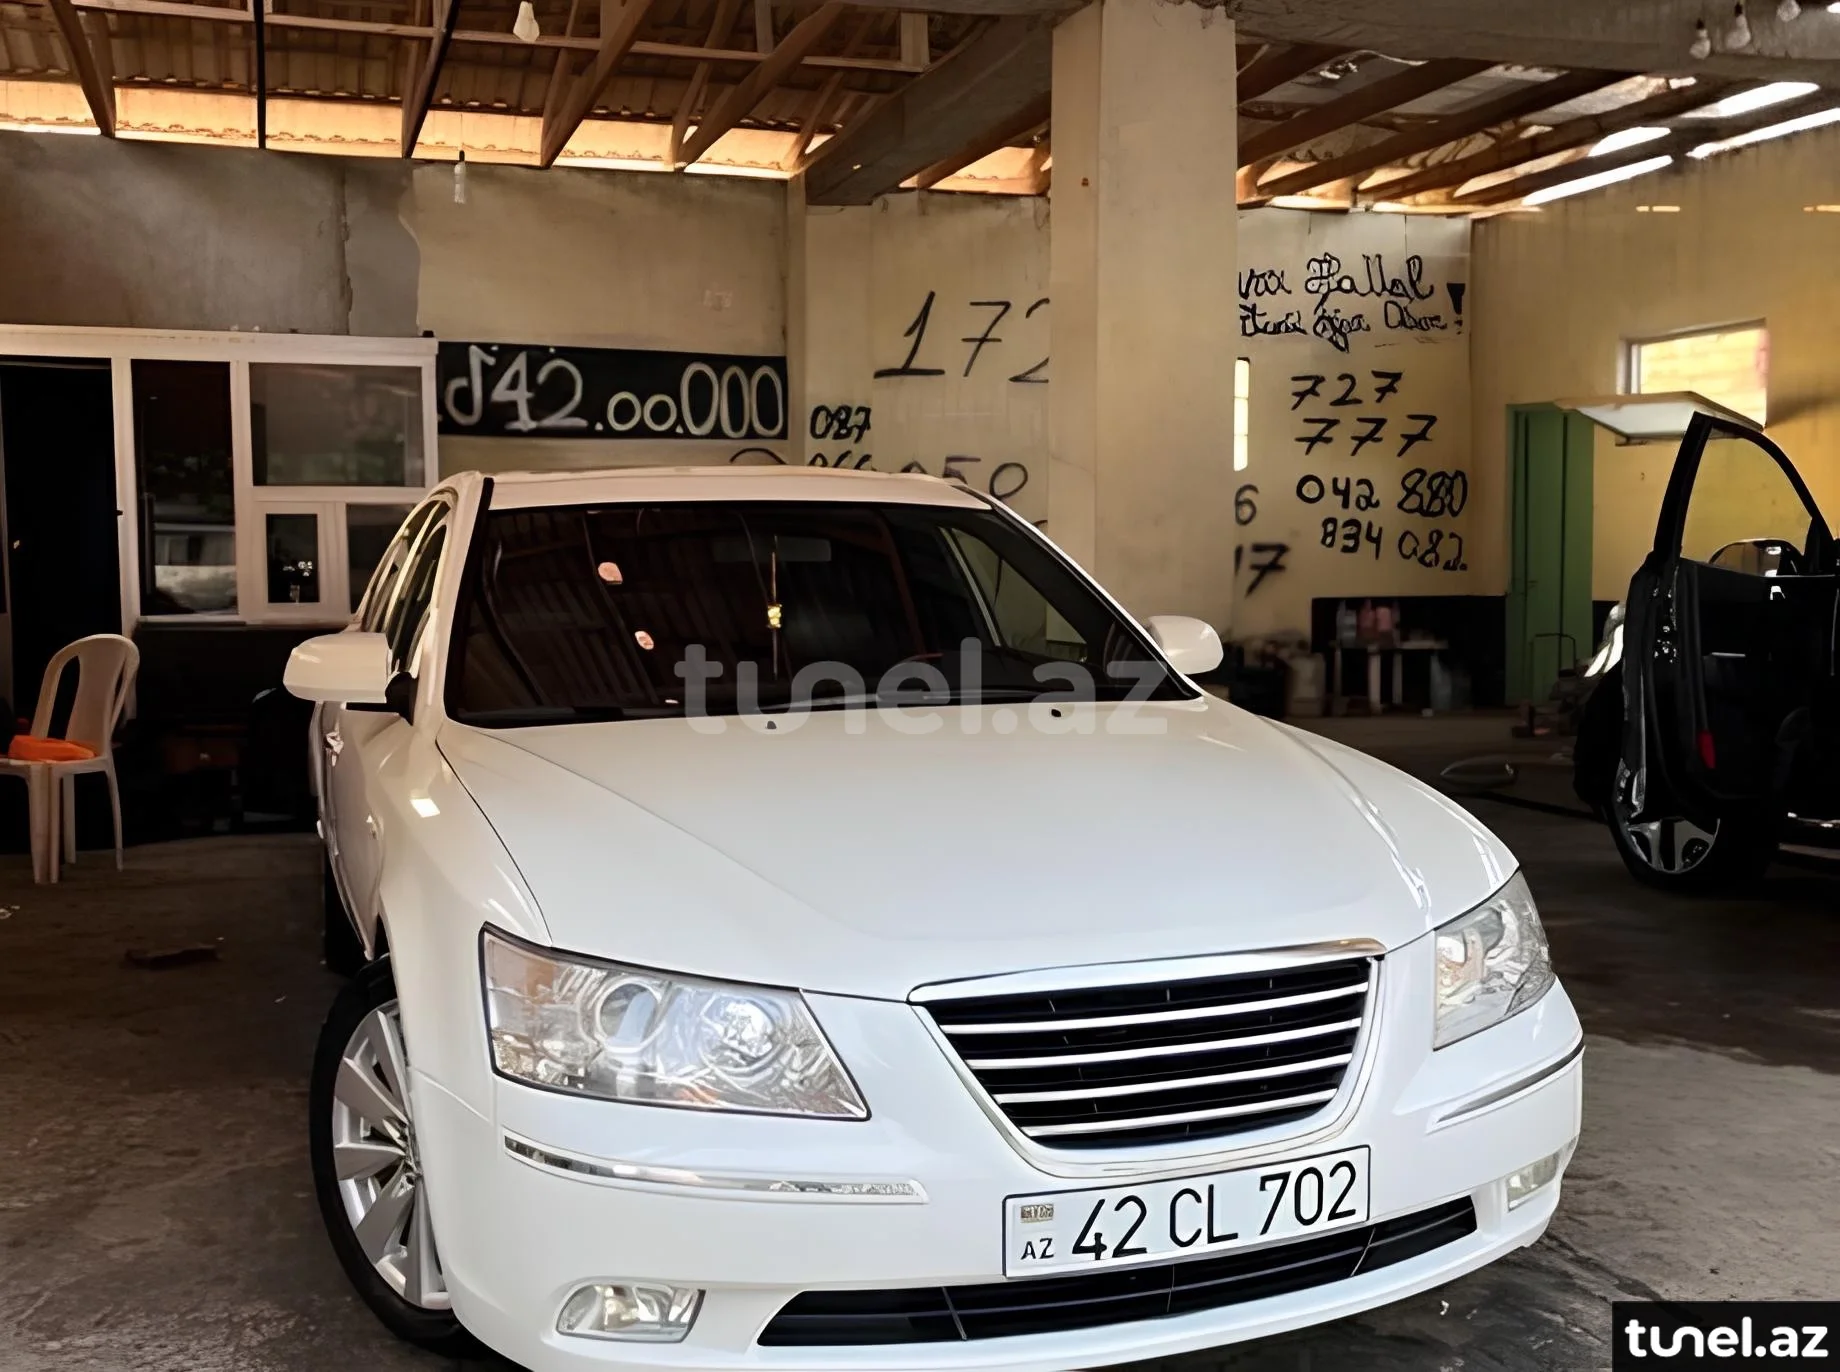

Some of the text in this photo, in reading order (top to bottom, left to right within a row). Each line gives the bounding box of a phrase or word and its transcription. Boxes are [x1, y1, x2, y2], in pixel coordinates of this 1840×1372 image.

[1291, 370, 1403, 411] 727
[1294, 414, 1438, 458] 777
[1296, 474, 1381, 511] 042
[1321, 517, 1383, 560] 834
[1072, 1160, 1357, 1260] 42 CL 702
[1020, 1237, 1055, 1260] AZ
